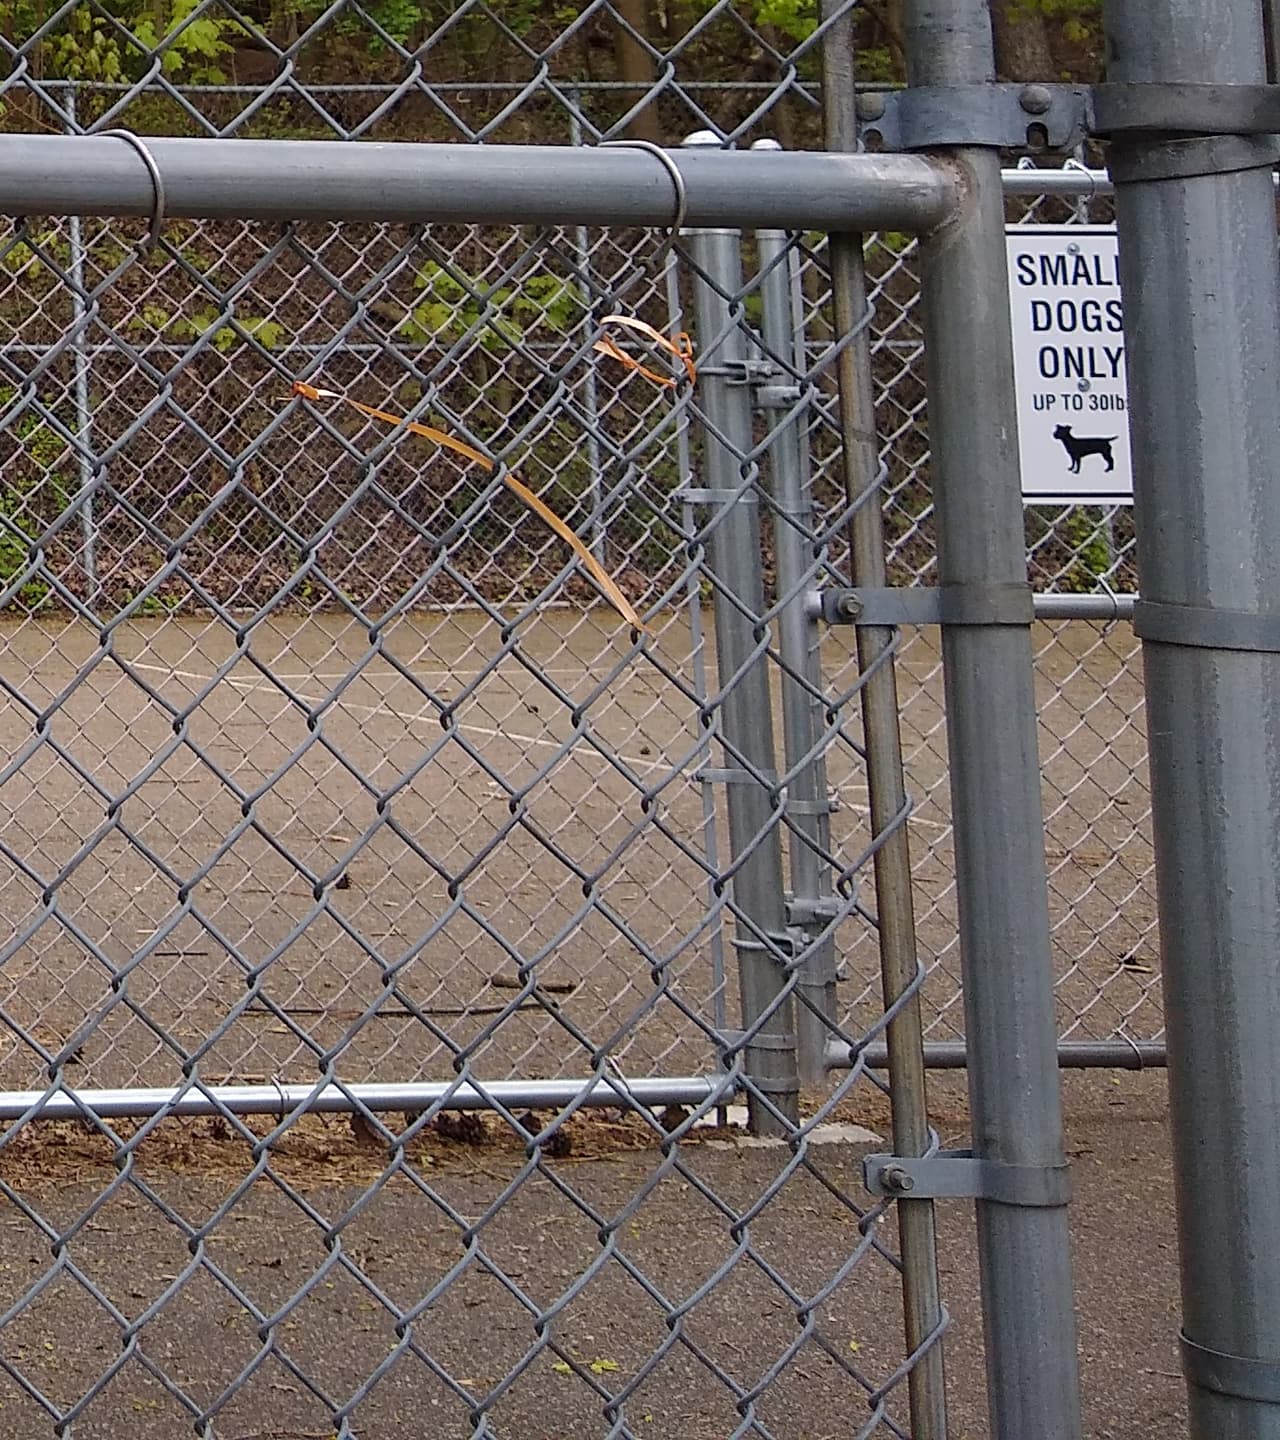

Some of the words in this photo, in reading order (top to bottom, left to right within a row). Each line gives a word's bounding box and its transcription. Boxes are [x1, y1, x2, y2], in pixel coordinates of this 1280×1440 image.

[1031, 300, 1124, 333] DOGS
[1039, 345, 1125, 379] ONLY
[1032, 393, 1057, 411] UP
[1060, 393, 1084, 411] TO
[1088, 393, 1127, 411] 30lb
